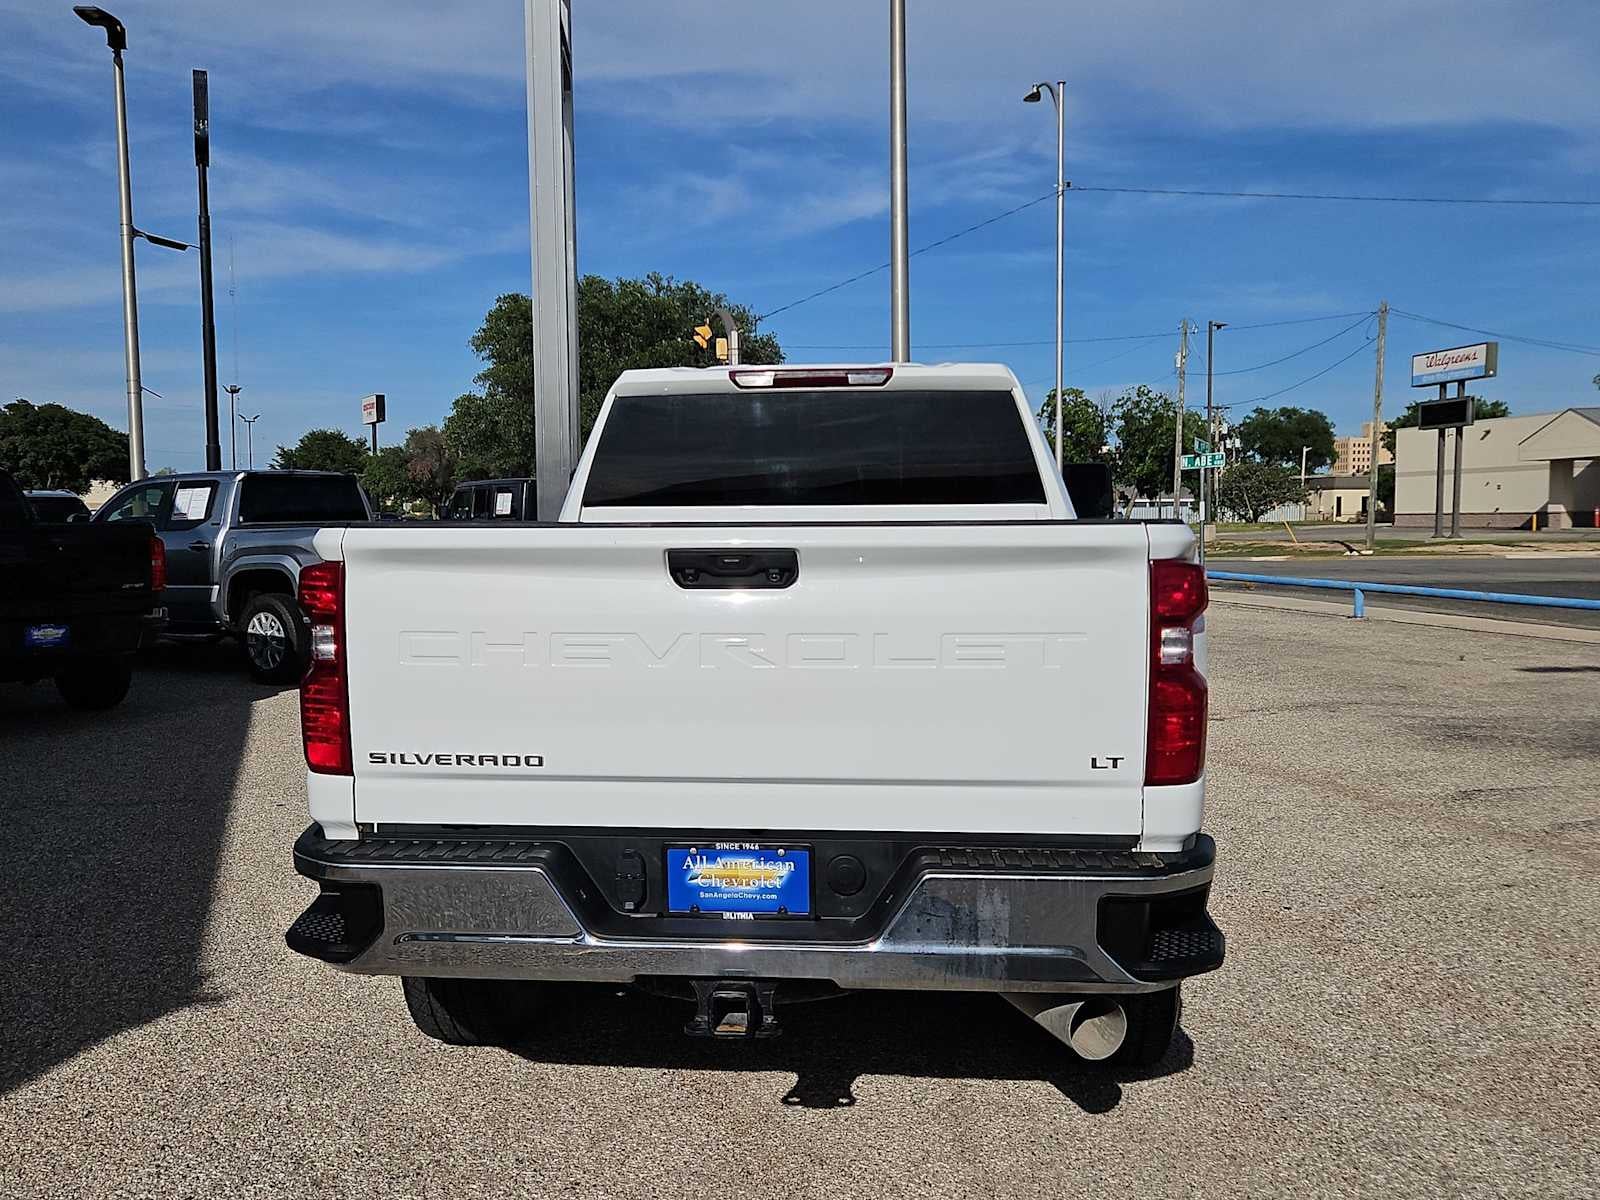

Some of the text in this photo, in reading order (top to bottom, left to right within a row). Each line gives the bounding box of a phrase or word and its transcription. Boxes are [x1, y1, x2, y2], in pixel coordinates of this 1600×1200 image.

[1426, 351, 1478, 369] Walgreens
[1195, 455, 1212, 467] ABE
[398, 630, 1088, 671] CHEVROLET
[369, 752, 544, 767] SILVERADO
[1091, 757, 1124, 769] LT
[715, 842, 740, 850] SINCE
[682, 855, 795, 872] All American
[698, 874, 783, 889] Chevrolet
[699, 891, 778, 901] SanAngeloChevy.com
[729, 912, 754, 920] LITHIA
